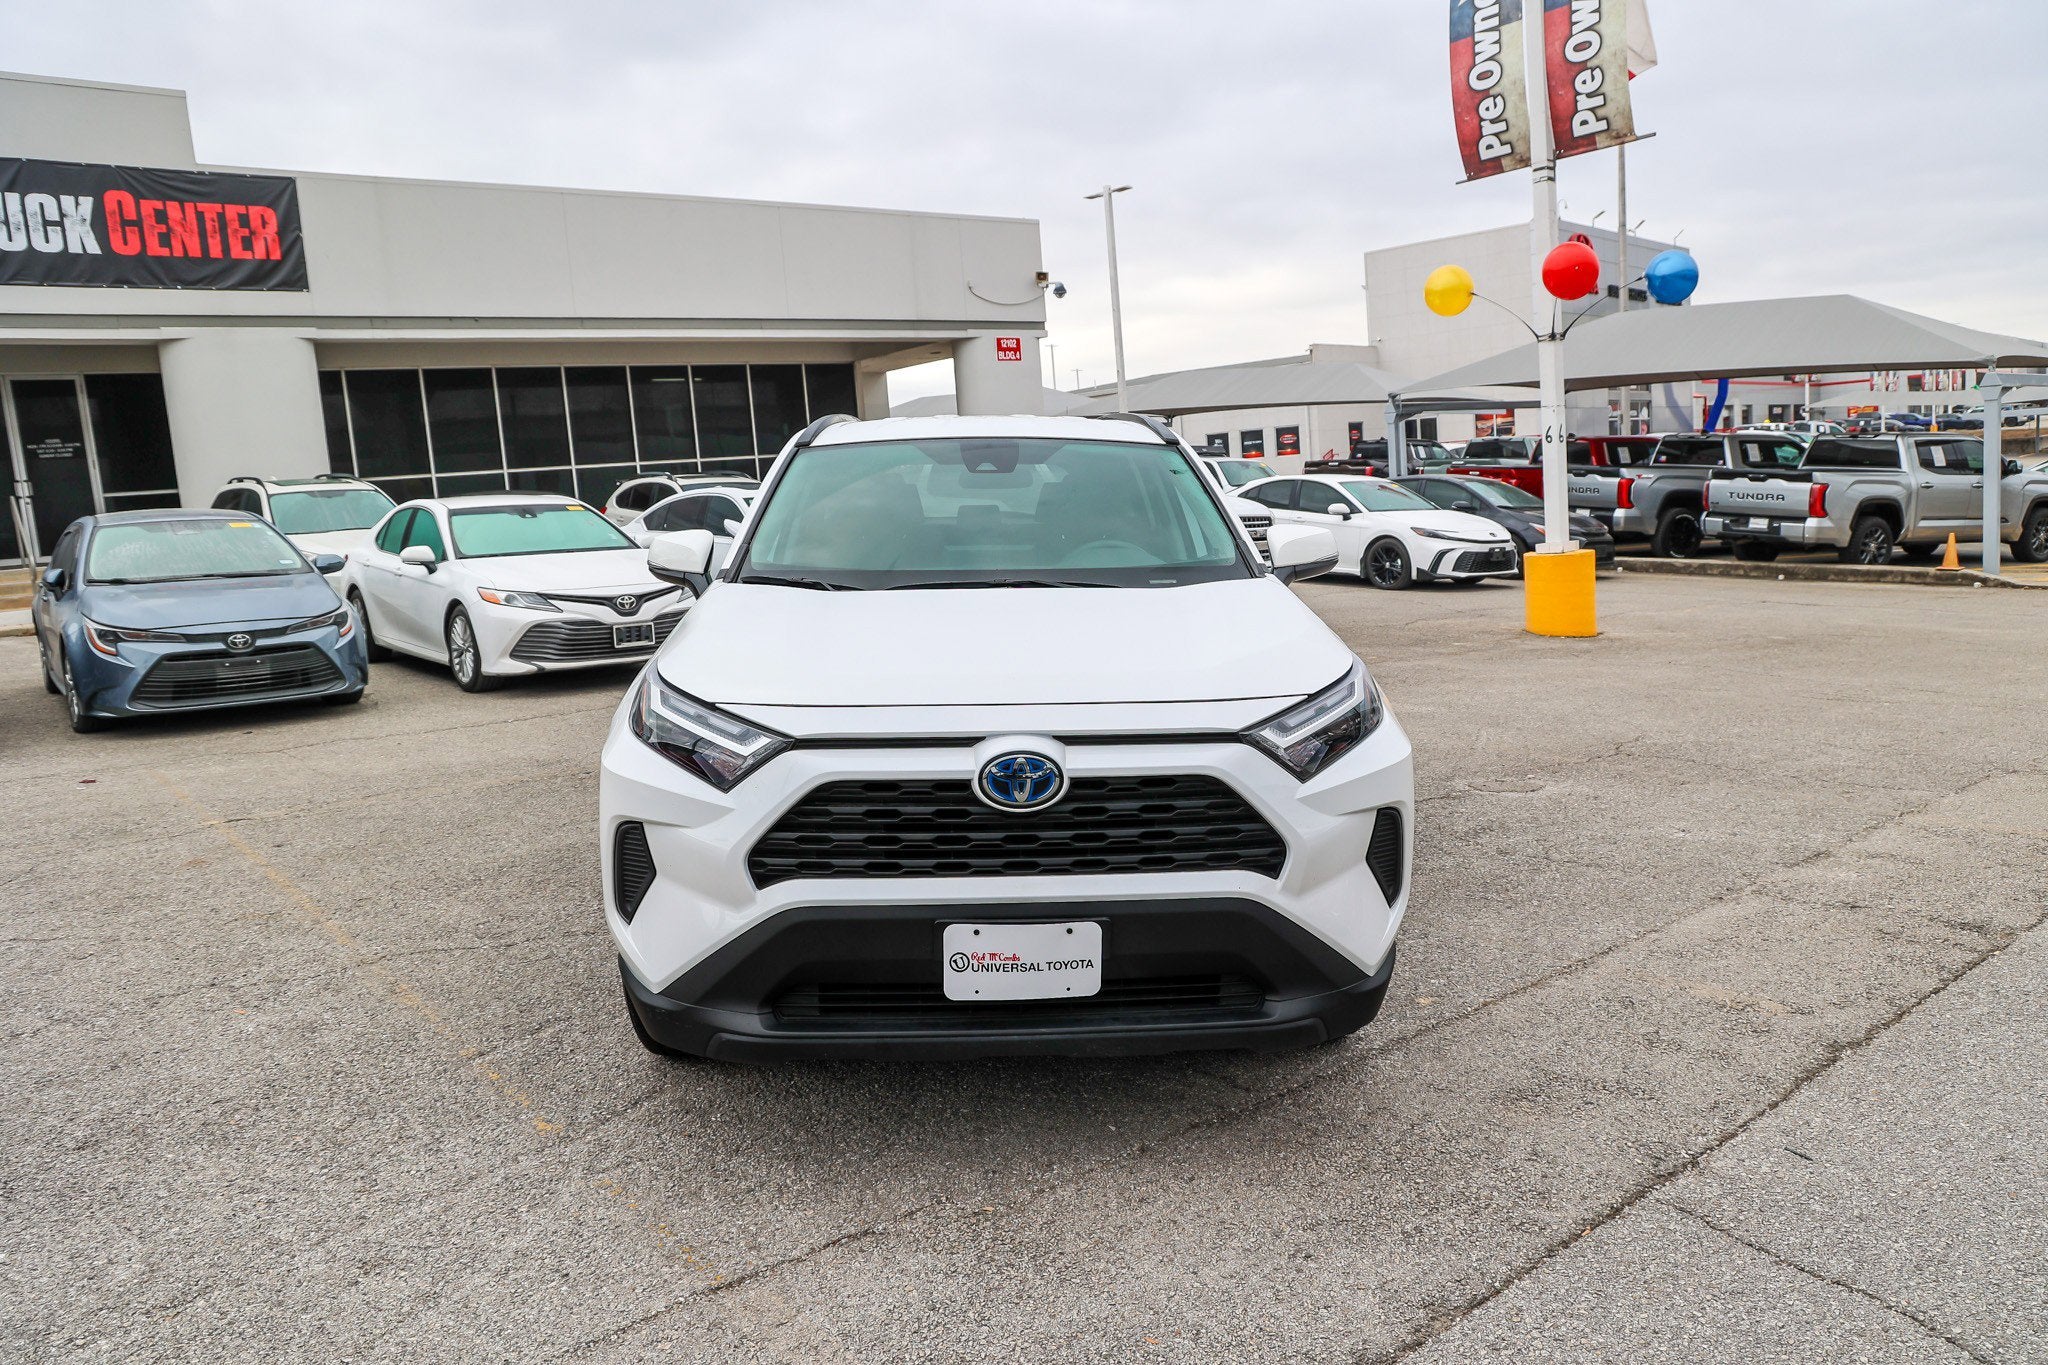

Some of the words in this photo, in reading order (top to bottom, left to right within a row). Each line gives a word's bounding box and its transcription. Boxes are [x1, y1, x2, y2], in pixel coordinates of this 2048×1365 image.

[1572, 67, 1609, 138] Pre
[1478, 94, 1513, 161] Pre
[102, 189, 282, 261] CENTER
[1728, 492, 1786, 502] TUNDRA
[971, 952, 986, 964] Red
[971, 963, 1044, 973] UNIVERSAL
[1046, 959, 1094, 971] TOYOTA
